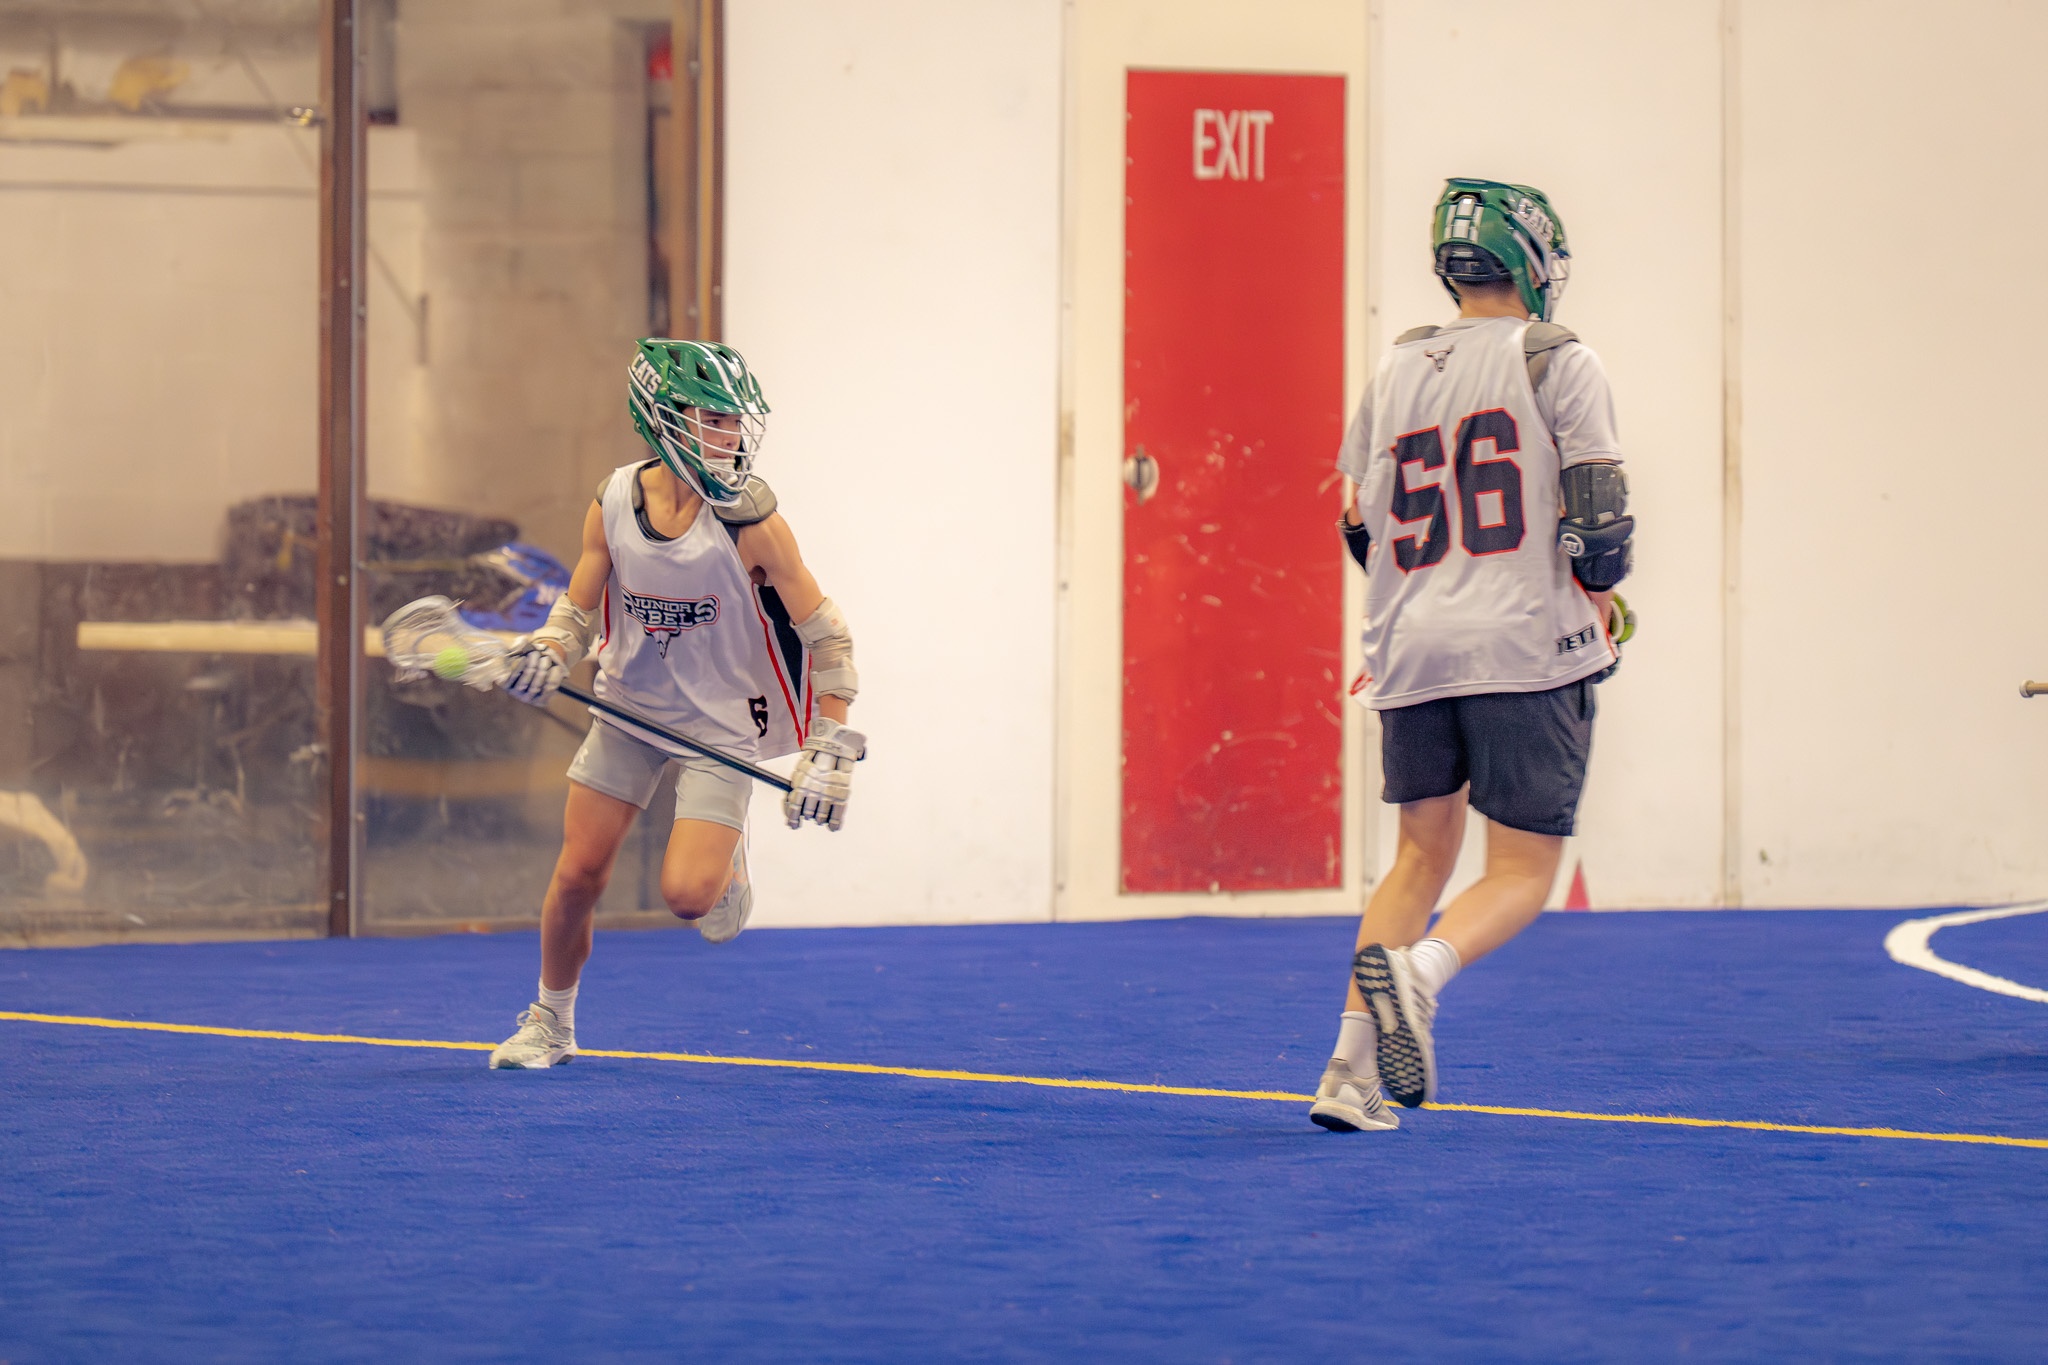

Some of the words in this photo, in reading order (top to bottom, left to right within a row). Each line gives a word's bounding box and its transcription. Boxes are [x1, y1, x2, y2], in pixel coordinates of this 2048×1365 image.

[1193, 108, 1274, 181] EXIT
[1517, 197, 1555, 242] CATS
[631, 352, 663, 395] CATS
[1389, 406, 1526, 575] 56
[634, 597, 693, 613] JUNIOR
